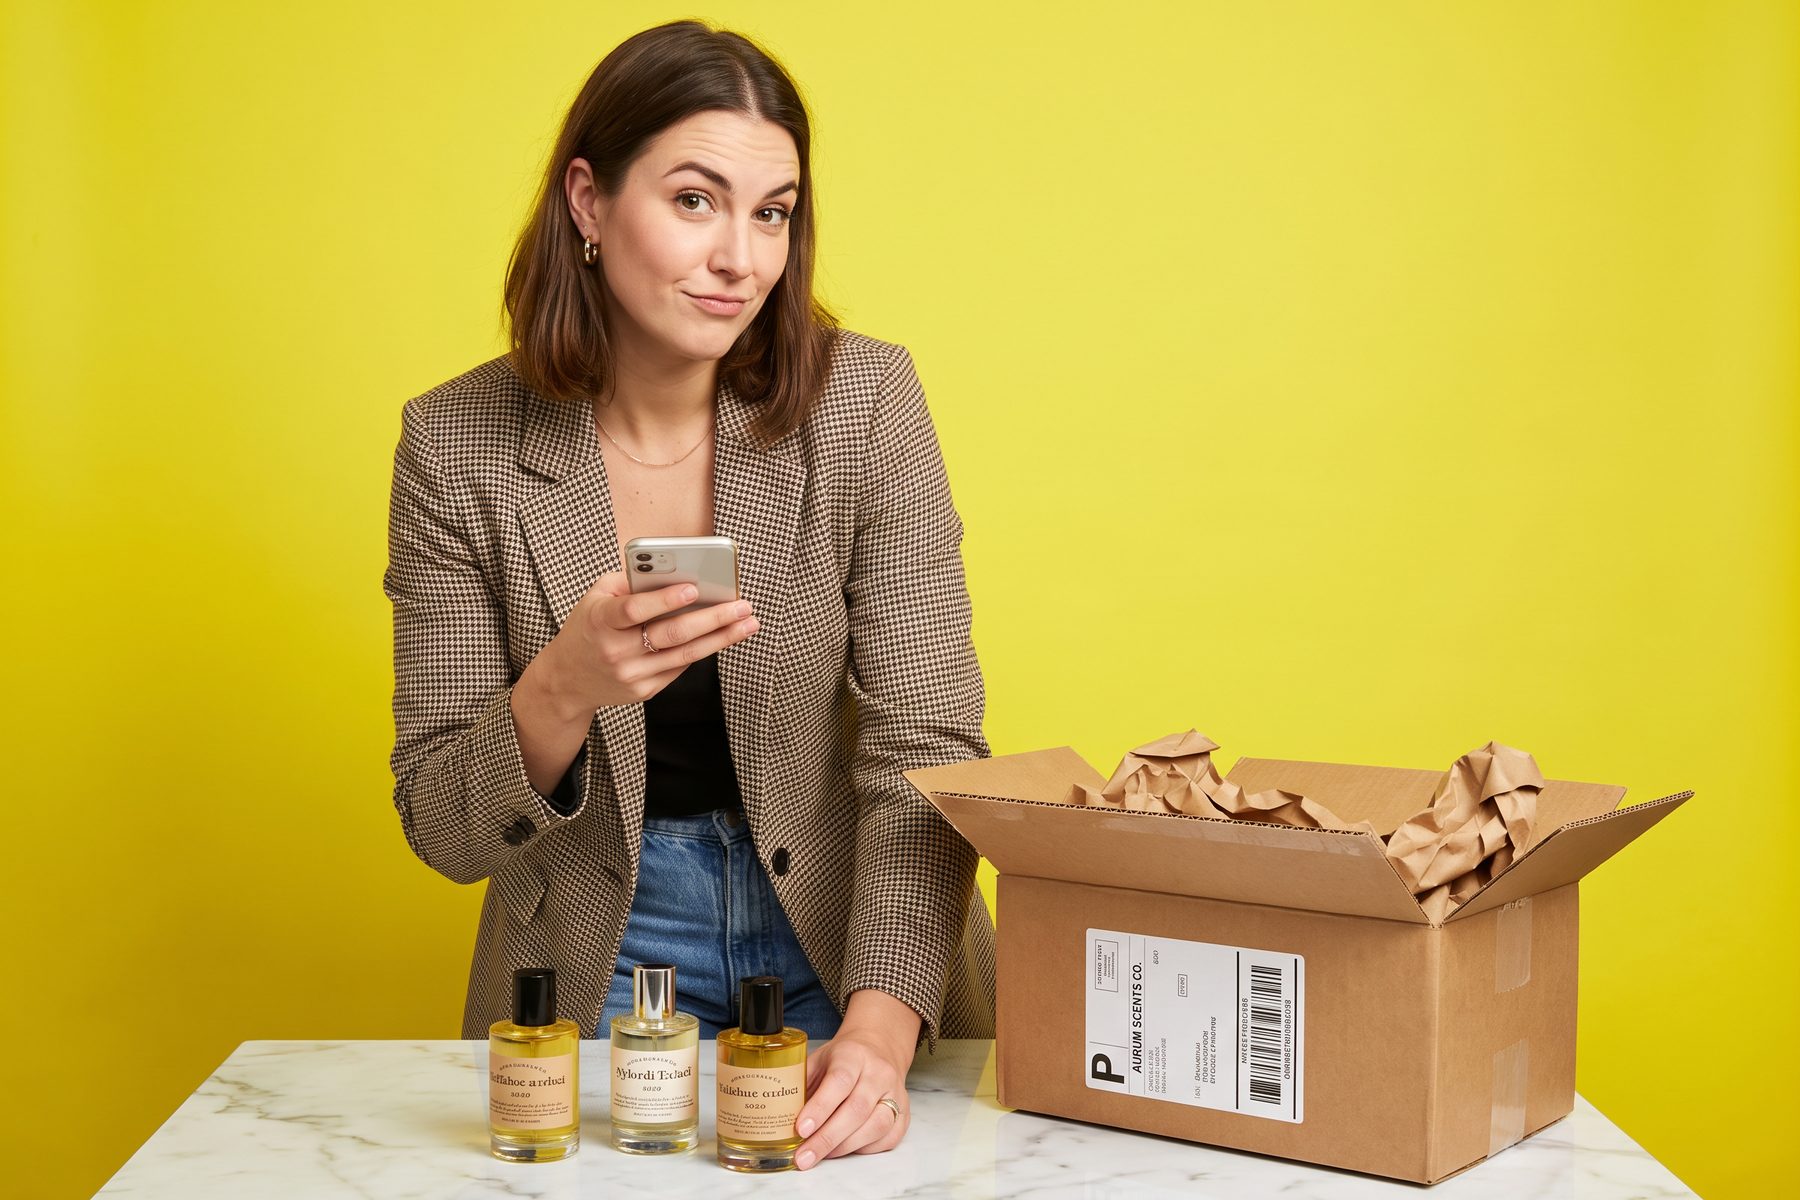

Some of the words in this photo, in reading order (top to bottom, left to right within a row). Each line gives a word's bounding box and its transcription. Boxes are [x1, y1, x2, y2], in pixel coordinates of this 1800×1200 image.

[1132, 962, 1143, 981] CO.
[1132, 982, 1143, 1029] SCENTS
[1091, 1053, 1125, 1085] P
[1132, 1030, 1143, 1074] AURUM
